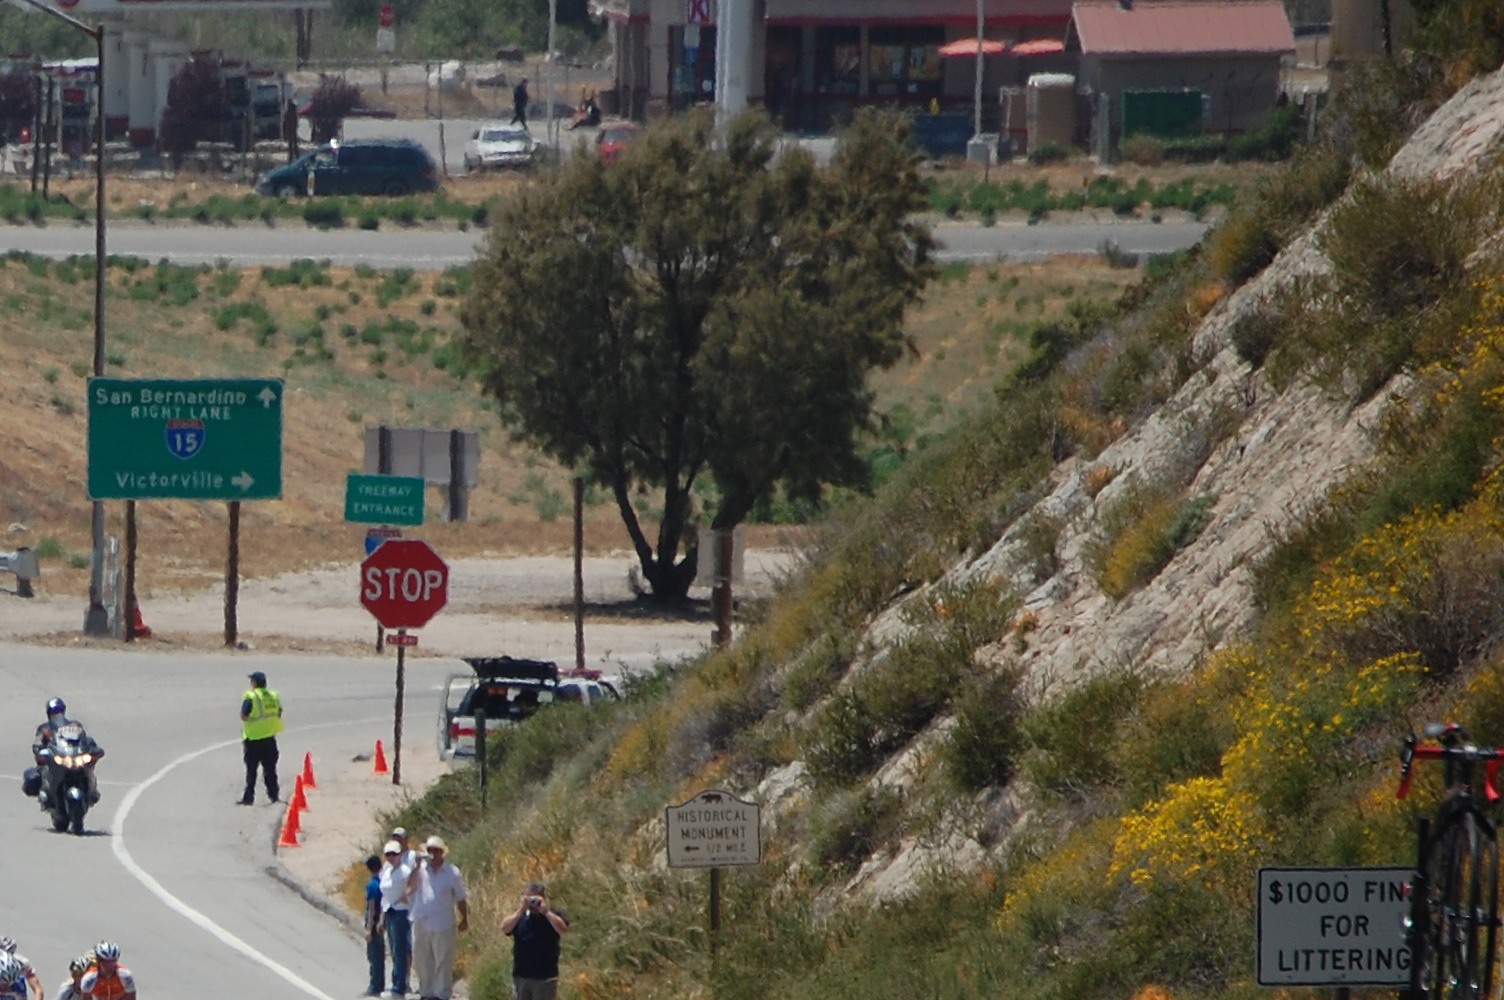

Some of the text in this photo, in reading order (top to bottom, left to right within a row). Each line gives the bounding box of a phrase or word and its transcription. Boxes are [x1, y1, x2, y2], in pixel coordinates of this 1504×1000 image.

[96, 388, 247, 405] San Bernardino
[131, 406, 232, 420] RIGHT LANE
[174, 432, 198, 453] 15
[115, 471, 224, 489] Victorville
[358, 485, 413, 497] FREEWAY
[353, 502, 416, 517] ENTRANCE
[364, 566, 444, 603] STOP
[677, 809, 749, 823] HISTORICAL
[681, 826, 747, 840] MONUMENT
[706, 843, 722, 854] 1/2
[1269, 880, 1413, 905] $1000 FIN
[1320, 915, 1370, 938] FOR
[1278, 948, 1411, 972] LITTERING
